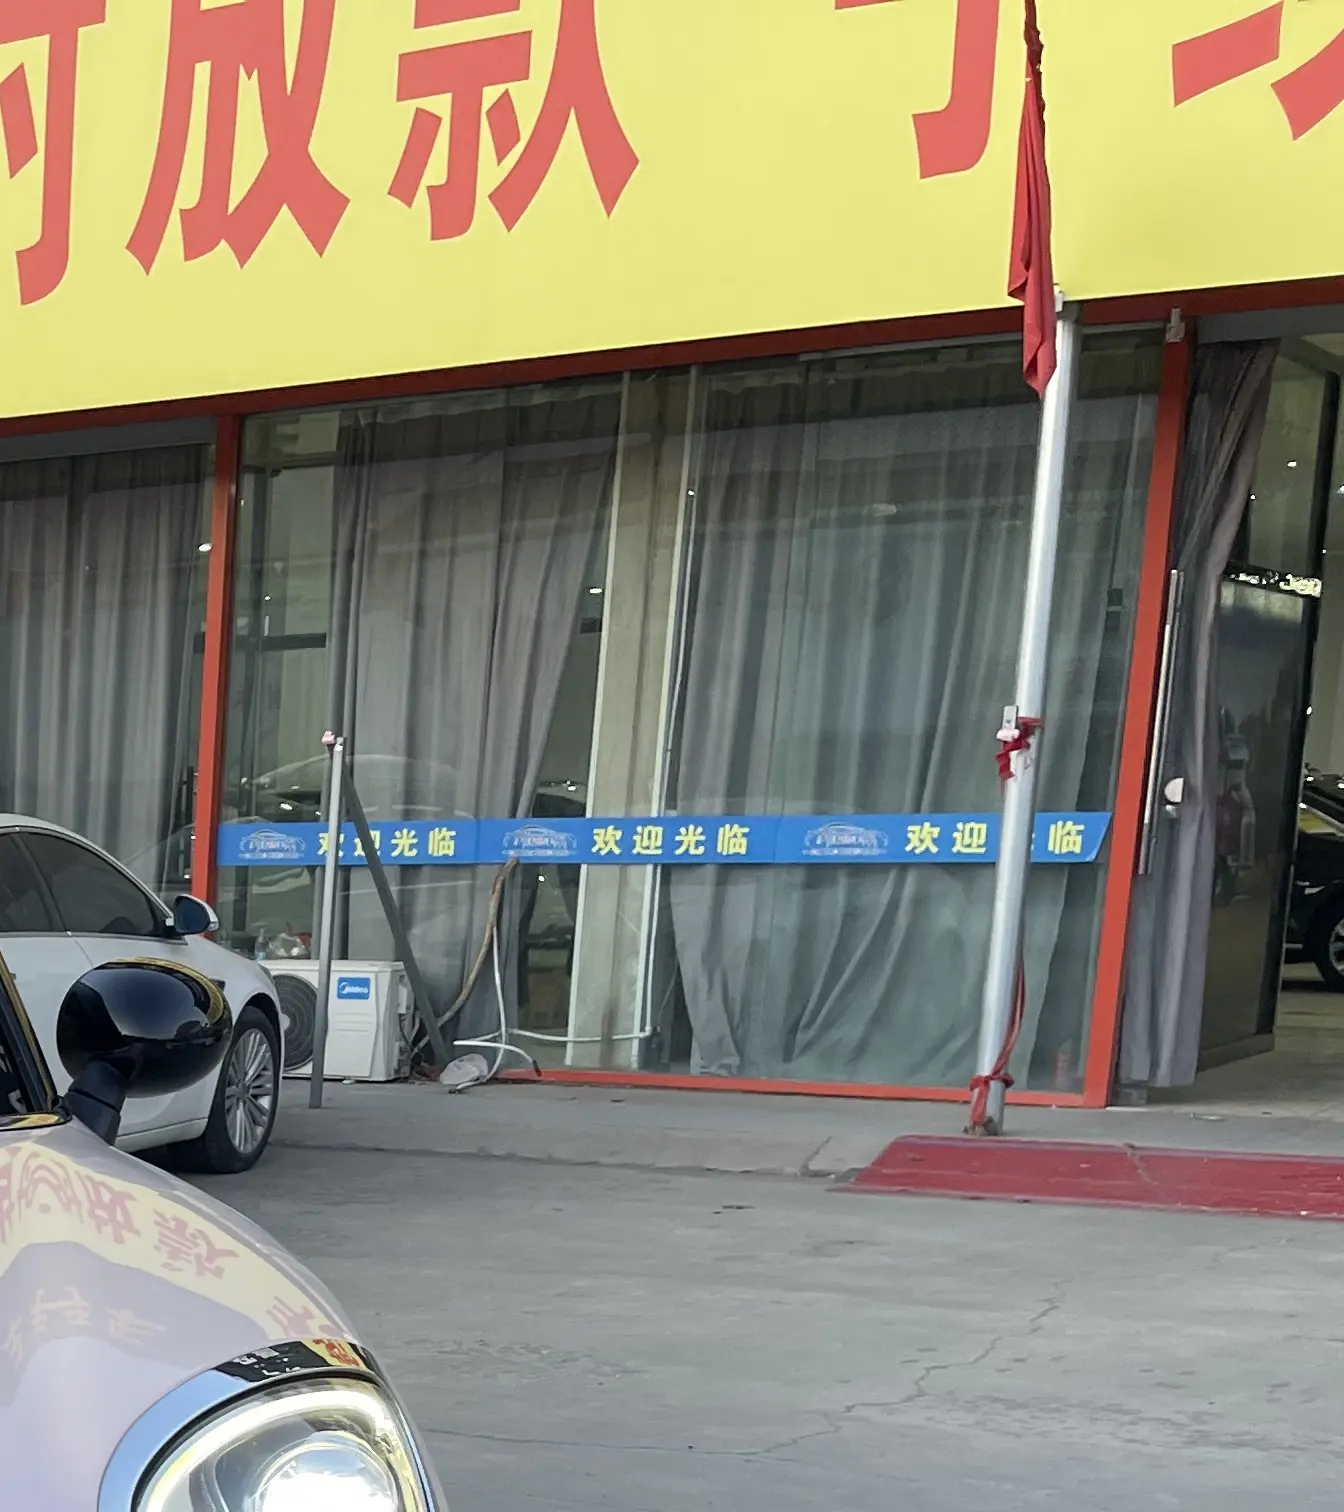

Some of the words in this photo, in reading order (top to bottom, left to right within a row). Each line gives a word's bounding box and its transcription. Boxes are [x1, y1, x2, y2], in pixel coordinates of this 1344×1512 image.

[590, 824, 750, 856] 欢迎光临
[904, 820, 1085, 855] 欢迎临
